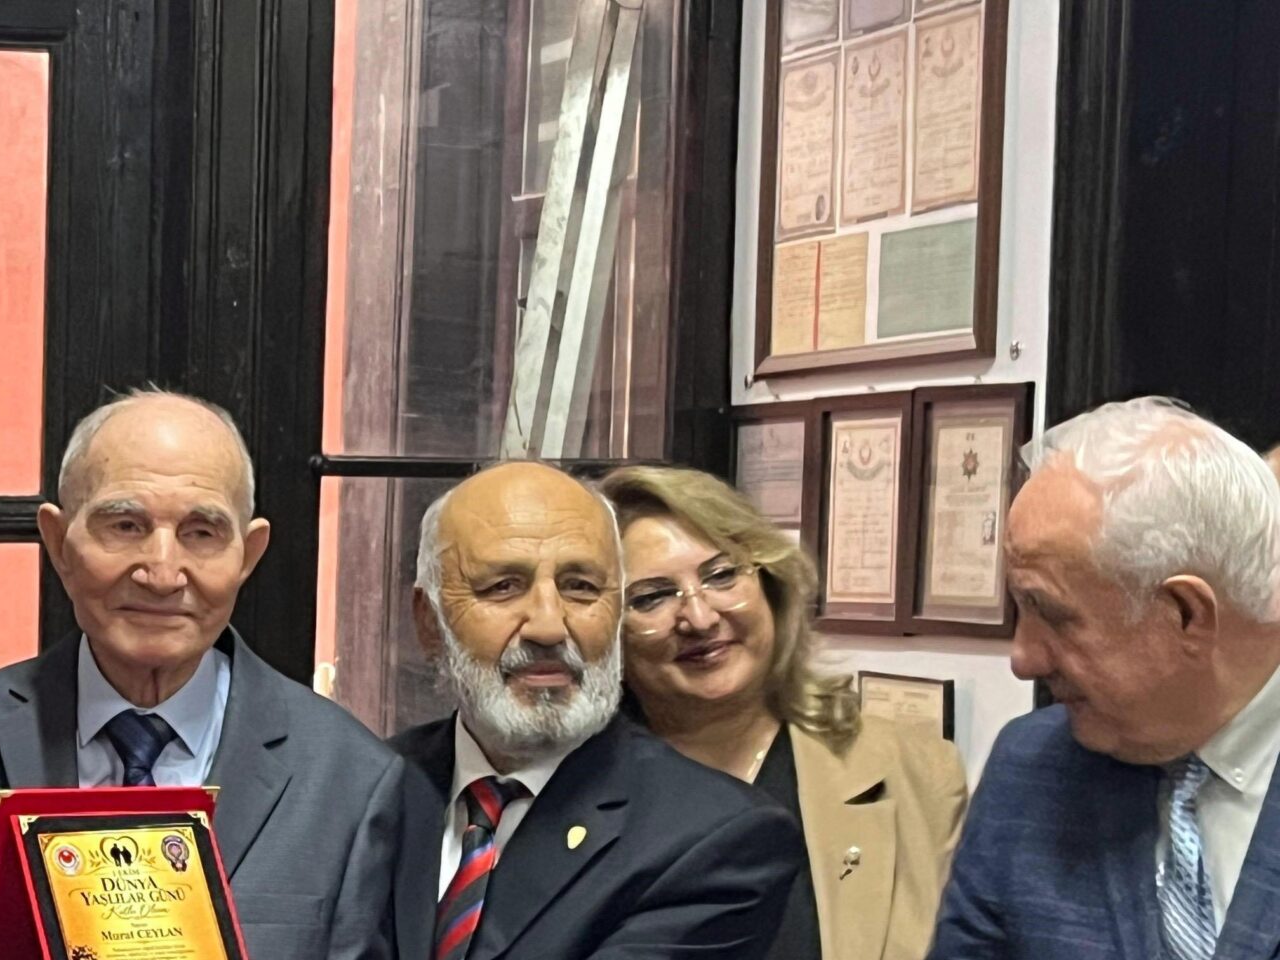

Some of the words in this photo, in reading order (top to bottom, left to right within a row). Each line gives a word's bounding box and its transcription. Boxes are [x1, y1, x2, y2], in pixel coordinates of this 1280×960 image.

[100, 875, 157, 891] DÜNYA
[80, 891, 146, 907] YAŞLILAR
[149, 886, 186, 903] GÜNÜ
[101, 931, 134, 941] Murat
[137, 927, 183, 939] CEYLAN
